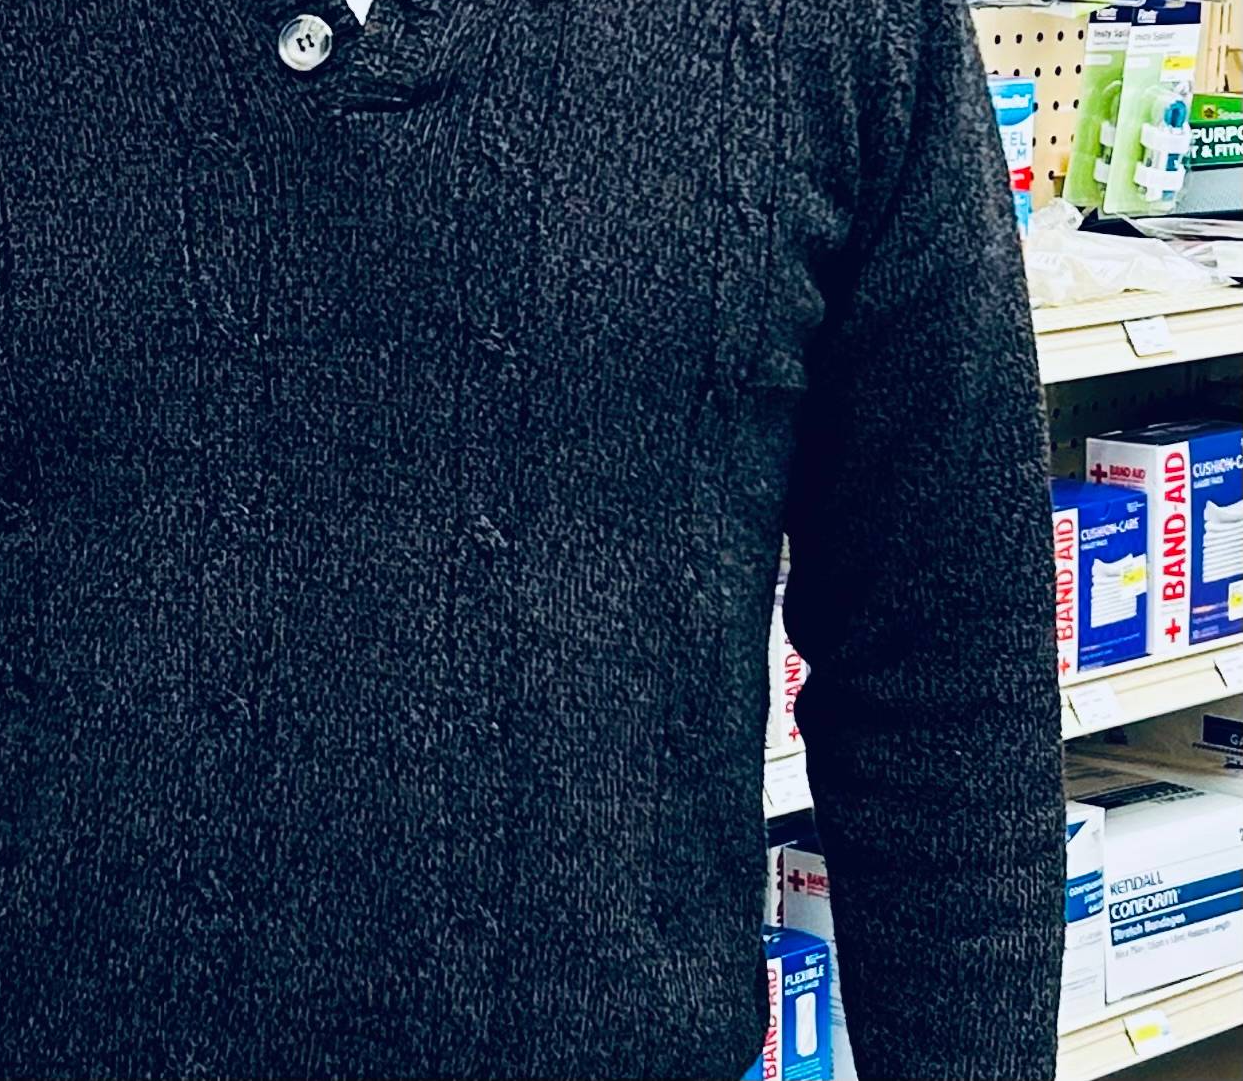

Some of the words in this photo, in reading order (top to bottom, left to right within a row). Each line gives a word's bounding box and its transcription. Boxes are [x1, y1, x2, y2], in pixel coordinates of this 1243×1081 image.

[1109, 870, 1164, 897] KENDALL
[1111, 888, 1181, 921] CONFORM
[784, 964, 825, 988] FLEXIBLE
